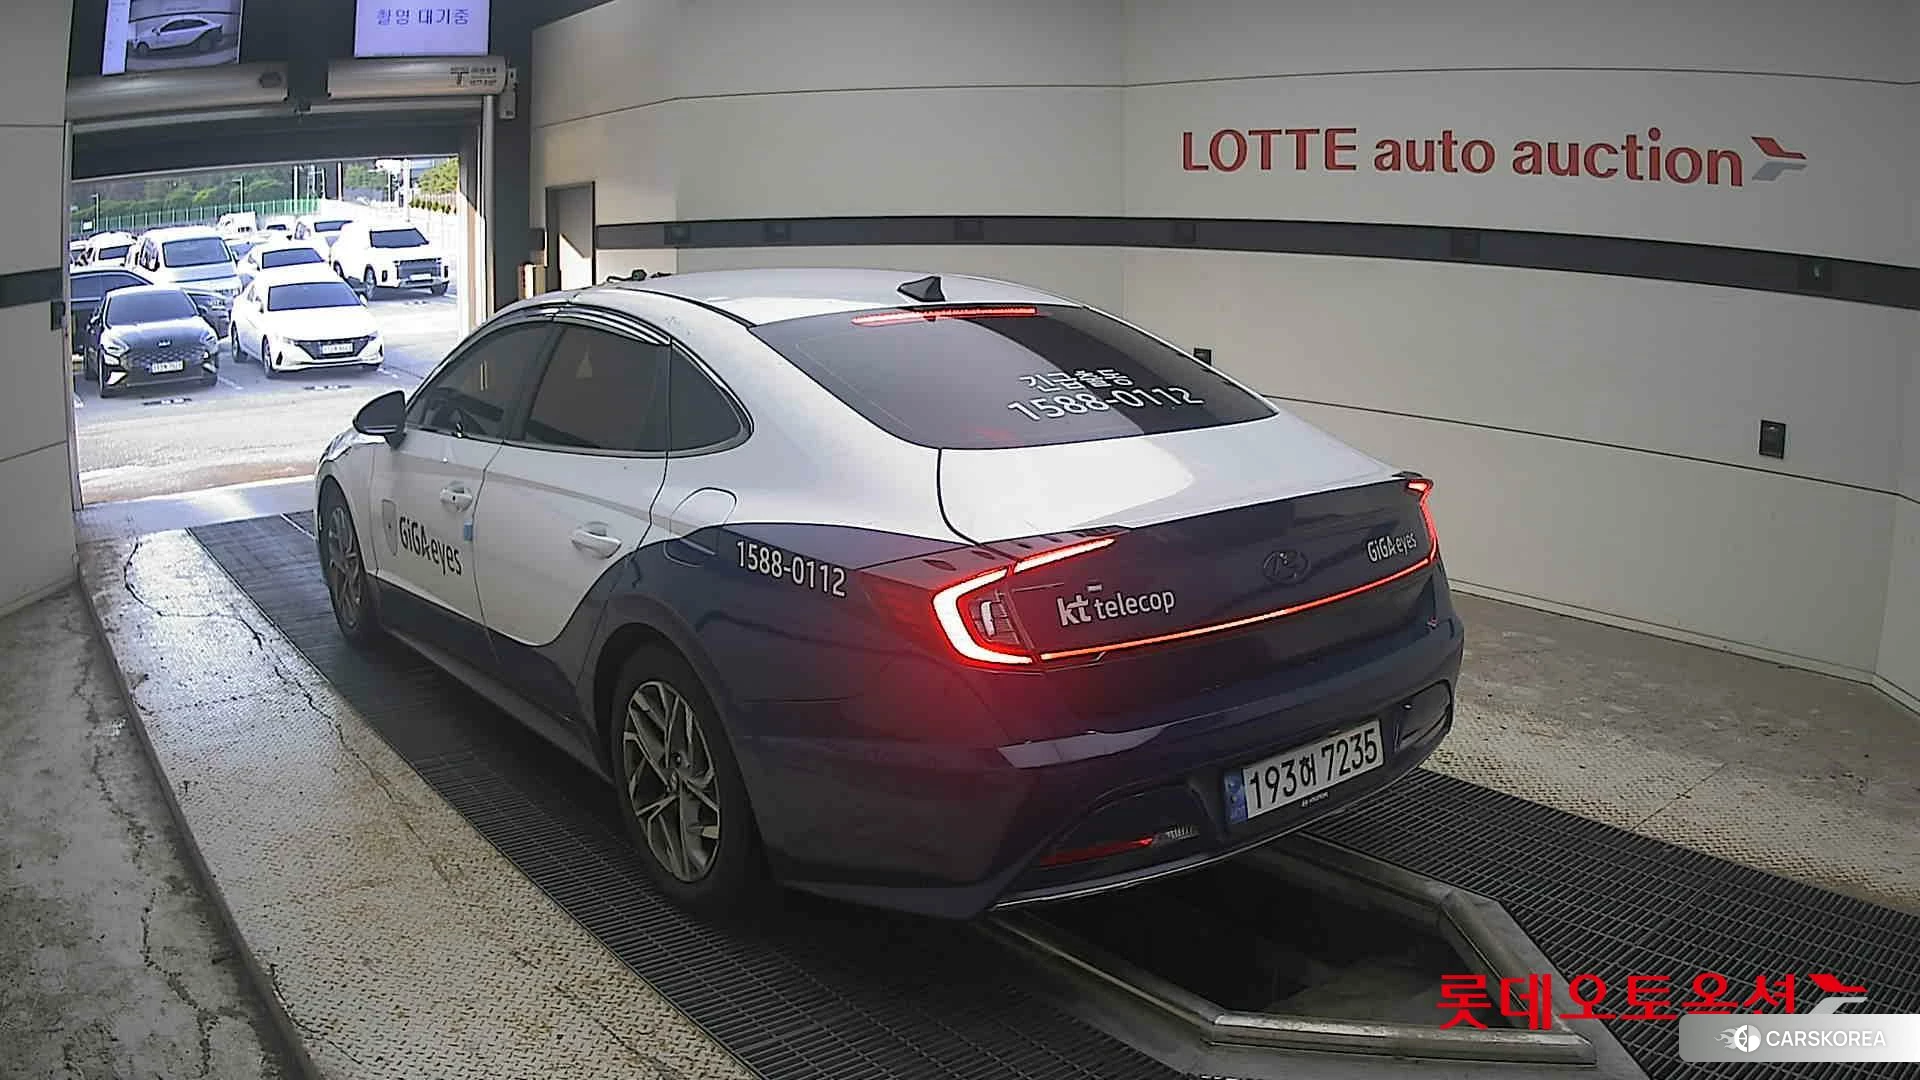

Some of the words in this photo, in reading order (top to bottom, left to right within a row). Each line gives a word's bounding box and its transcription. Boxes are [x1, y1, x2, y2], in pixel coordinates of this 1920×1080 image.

[1182, 127, 1358, 172] LOTTE
[1373, 129, 1495, 174] auto
[1511, 127, 1744, 187] auction
[1019, 369, 1134, 393] 긴급출동
[1007, 387, 1205, 421] 1588-0112
[737, 541, 845, 597] 1588-0112
[1056, 594, 1092, 626] kt
[1094, 591, 1175, 619] telecop
